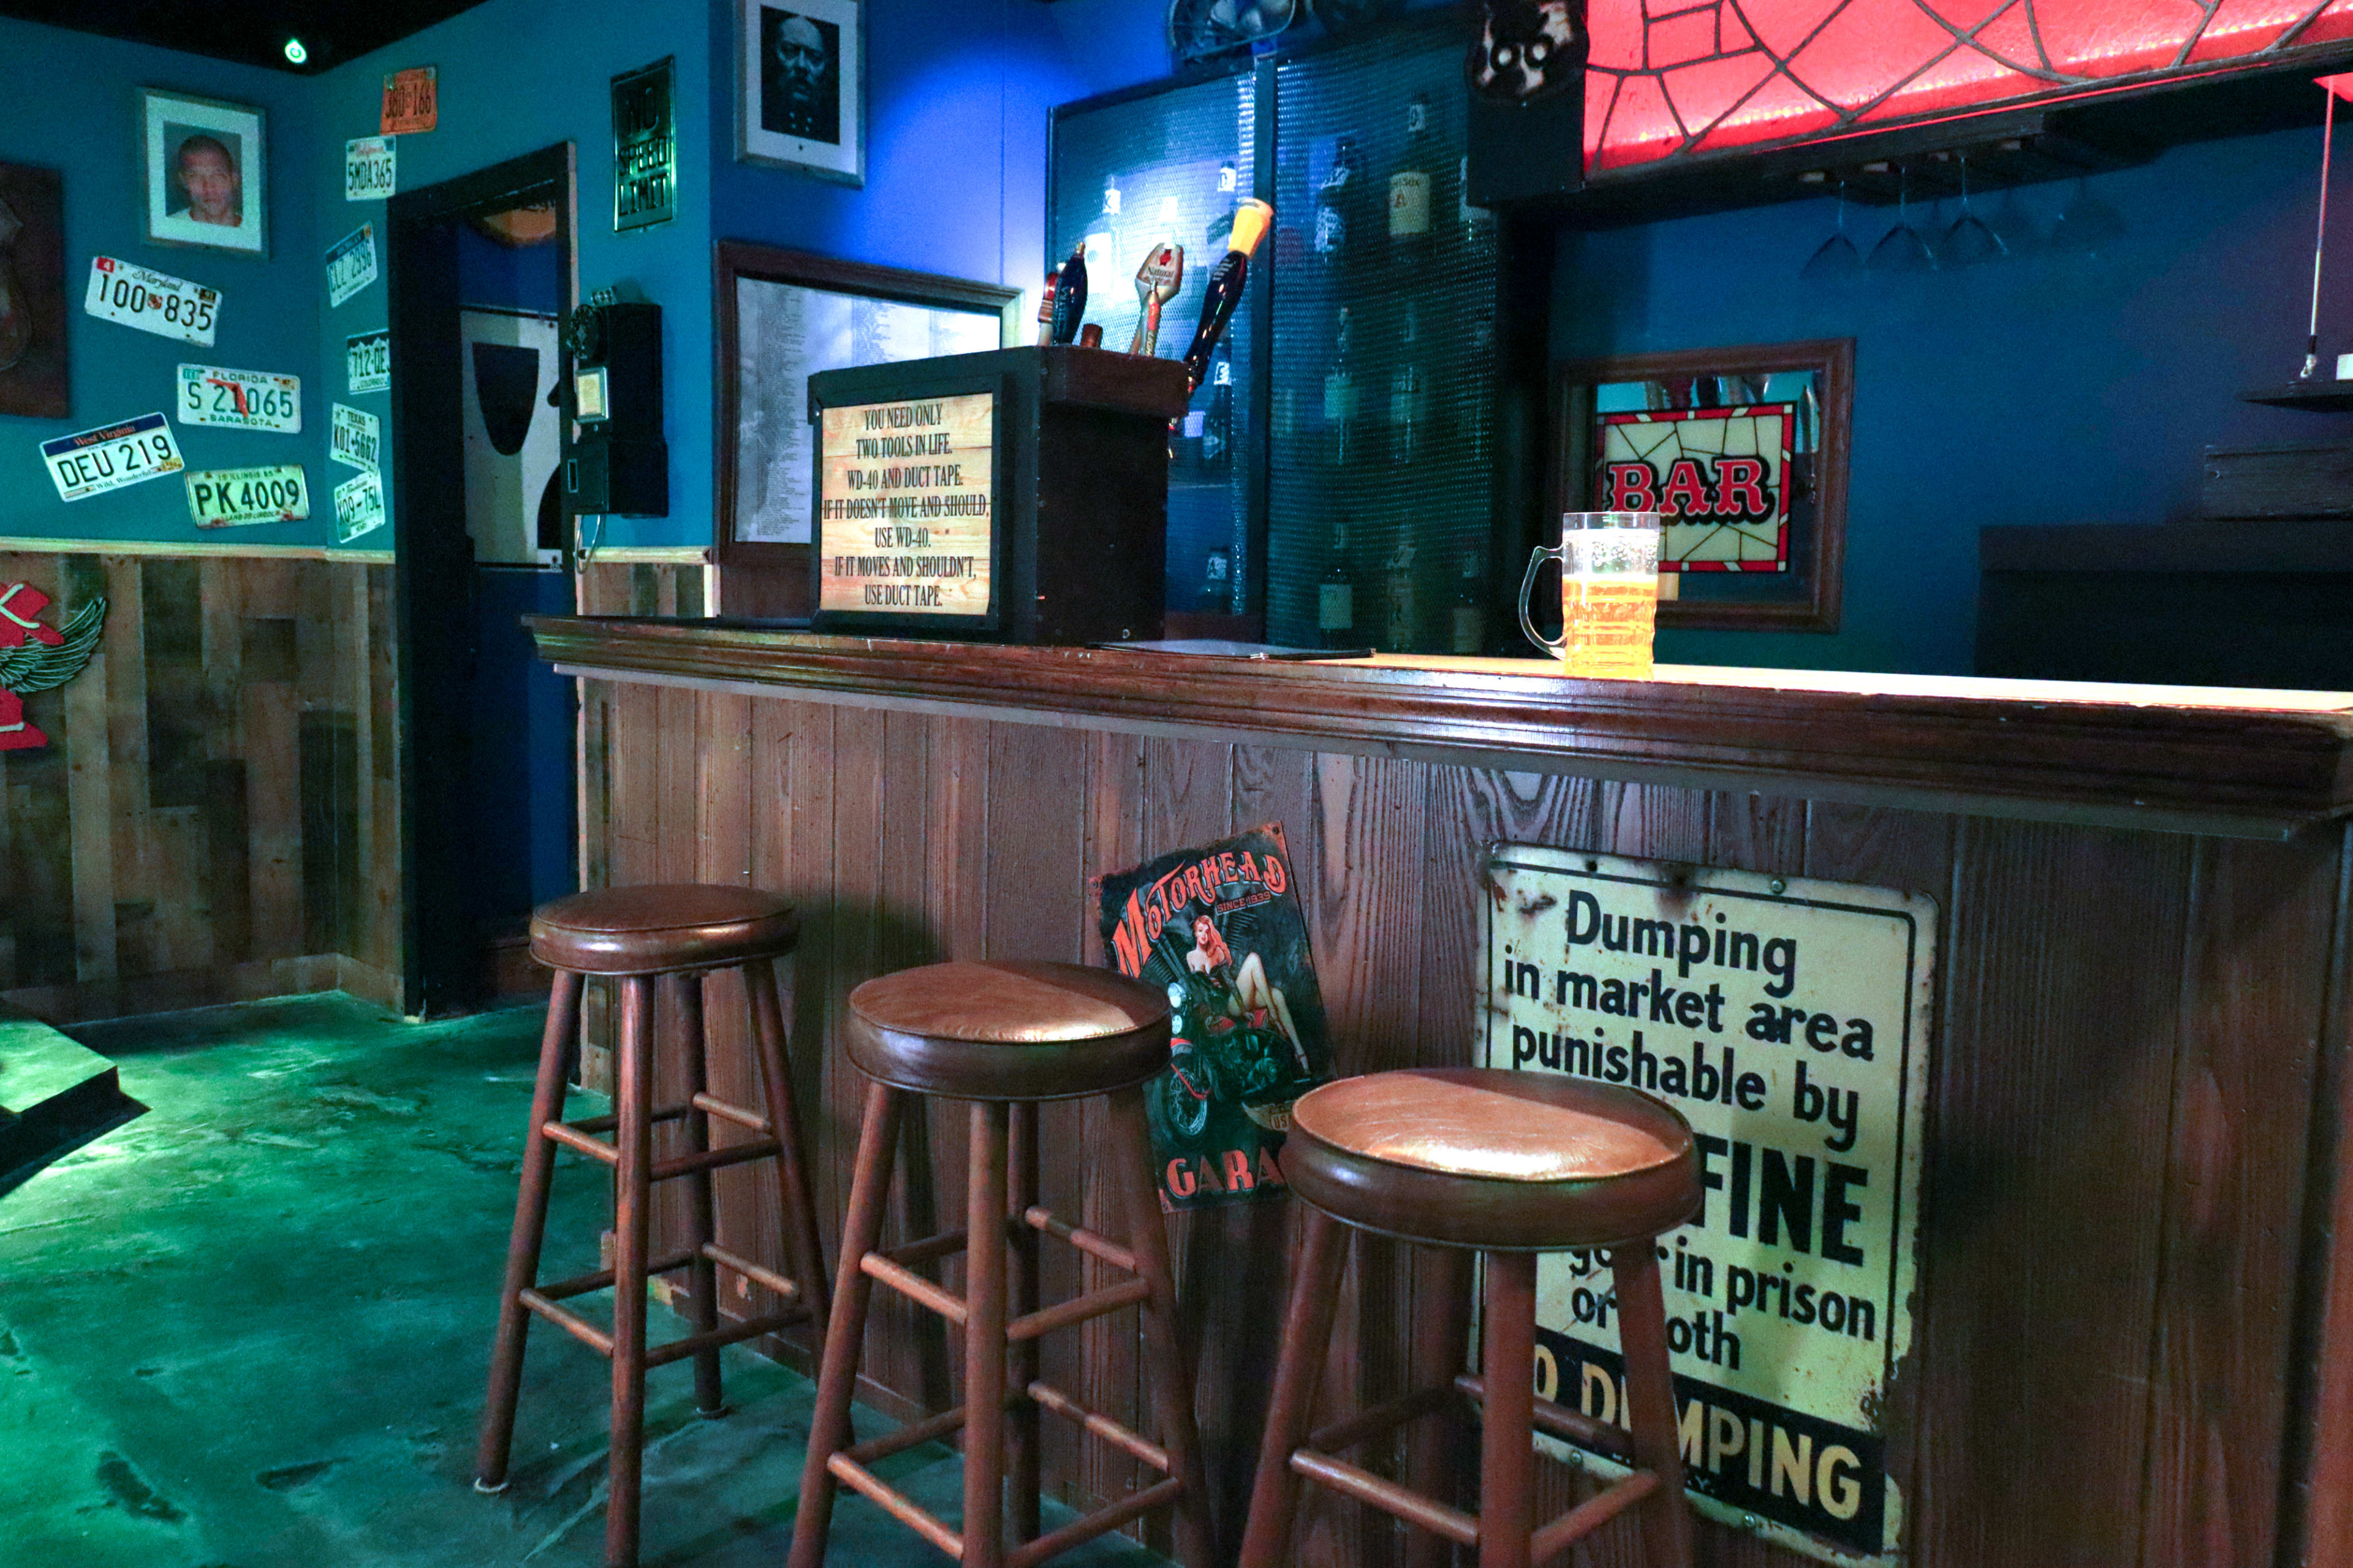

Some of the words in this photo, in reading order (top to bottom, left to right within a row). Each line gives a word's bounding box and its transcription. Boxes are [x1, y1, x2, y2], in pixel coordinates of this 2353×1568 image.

[619, 137, 667, 176] SPEED
[619, 173, 669, 216] LIMIT
[132, 270, 182, 292] Maryland
[1148, 266, 1174, 278] Natural
[100, 274, 146, 313] 100
[164, 294, 214, 331] 835
[213, 371, 267, 384] FLORIDA
[188, 382, 201, 410] S
[213, 383, 293, 419] 21065
[347, 411, 366, 426] TEXAS
[864, 409, 884, 430] YOU
[887, 406, 912, 429] NEED
[915, 403, 943, 426] ONLY
[74, 433, 98, 445] West
[99, 425, 136, 439] Virginia
[209, 414, 272, 426] SARASOTA
[57, 449, 115, 488] DEU
[118, 434, 172, 471] 219
[856, 438, 878, 460] TWO
[881, 436, 912, 458] TOOLS
[915, 434, 926, 456] IN
[928, 433, 953, 455] LIFE.
[847, 470, 878, 490] WD-40
[881, 468, 901, 489] AND
[904, 466, 930, 488] DUCT
[933, 464, 963, 487] TAPE.
[1607, 457, 1772, 520] BAR
[194, 482, 237, 517] PK
[240, 479, 299, 511] 4009
[824, 500, 833, 520] IF
[835, 499, 844, 519] IT
[846, 498, 887, 519] DOESN'T
[889, 496, 917, 518] MOVE
[921, 496, 941, 518] AND
[944, 494, 990, 518] SHOULD,
[874, 527, 893, 547] USE
[896, 527, 931, 547] WD-40.
[834, 556, 844, 576] IF
[846, 556, 855, 576] IT
[858, 556, 890, 577] MOVES
[893, 556, 914, 577] AND
[915, 556, 977, 579] SHOULDN'T,
[865, 585, 883, 605] USE
[885, 585, 911, 606] DUCT
[914, 585, 943, 607] TAPE.
[1217, 897, 1246, 913] SINCE
[1246, 890, 1271, 905] 1939
[1567, 888, 1797, 998] Dumping
[1504, 945, 1540, 1000] in
[1556, 969, 1725, 1034] market
[1746, 999, 1874, 1061] area
[1512, 1025, 1767, 1111] punishable
[1794, 1060, 1859, 1153] by
[1166, 1147, 1288, 1200] GARA
[1691, 1132, 1869, 1267] FINE
[1677, 1235, 1713, 1298] in
[1727, 1262, 1875, 1341] prison
[1572, 1287, 1618, 1329] or
[1667, 1309, 1741, 1370] oth
[1534, 1343, 1558, 1403] O
[1580, 1358, 1862, 1520] DMPING
